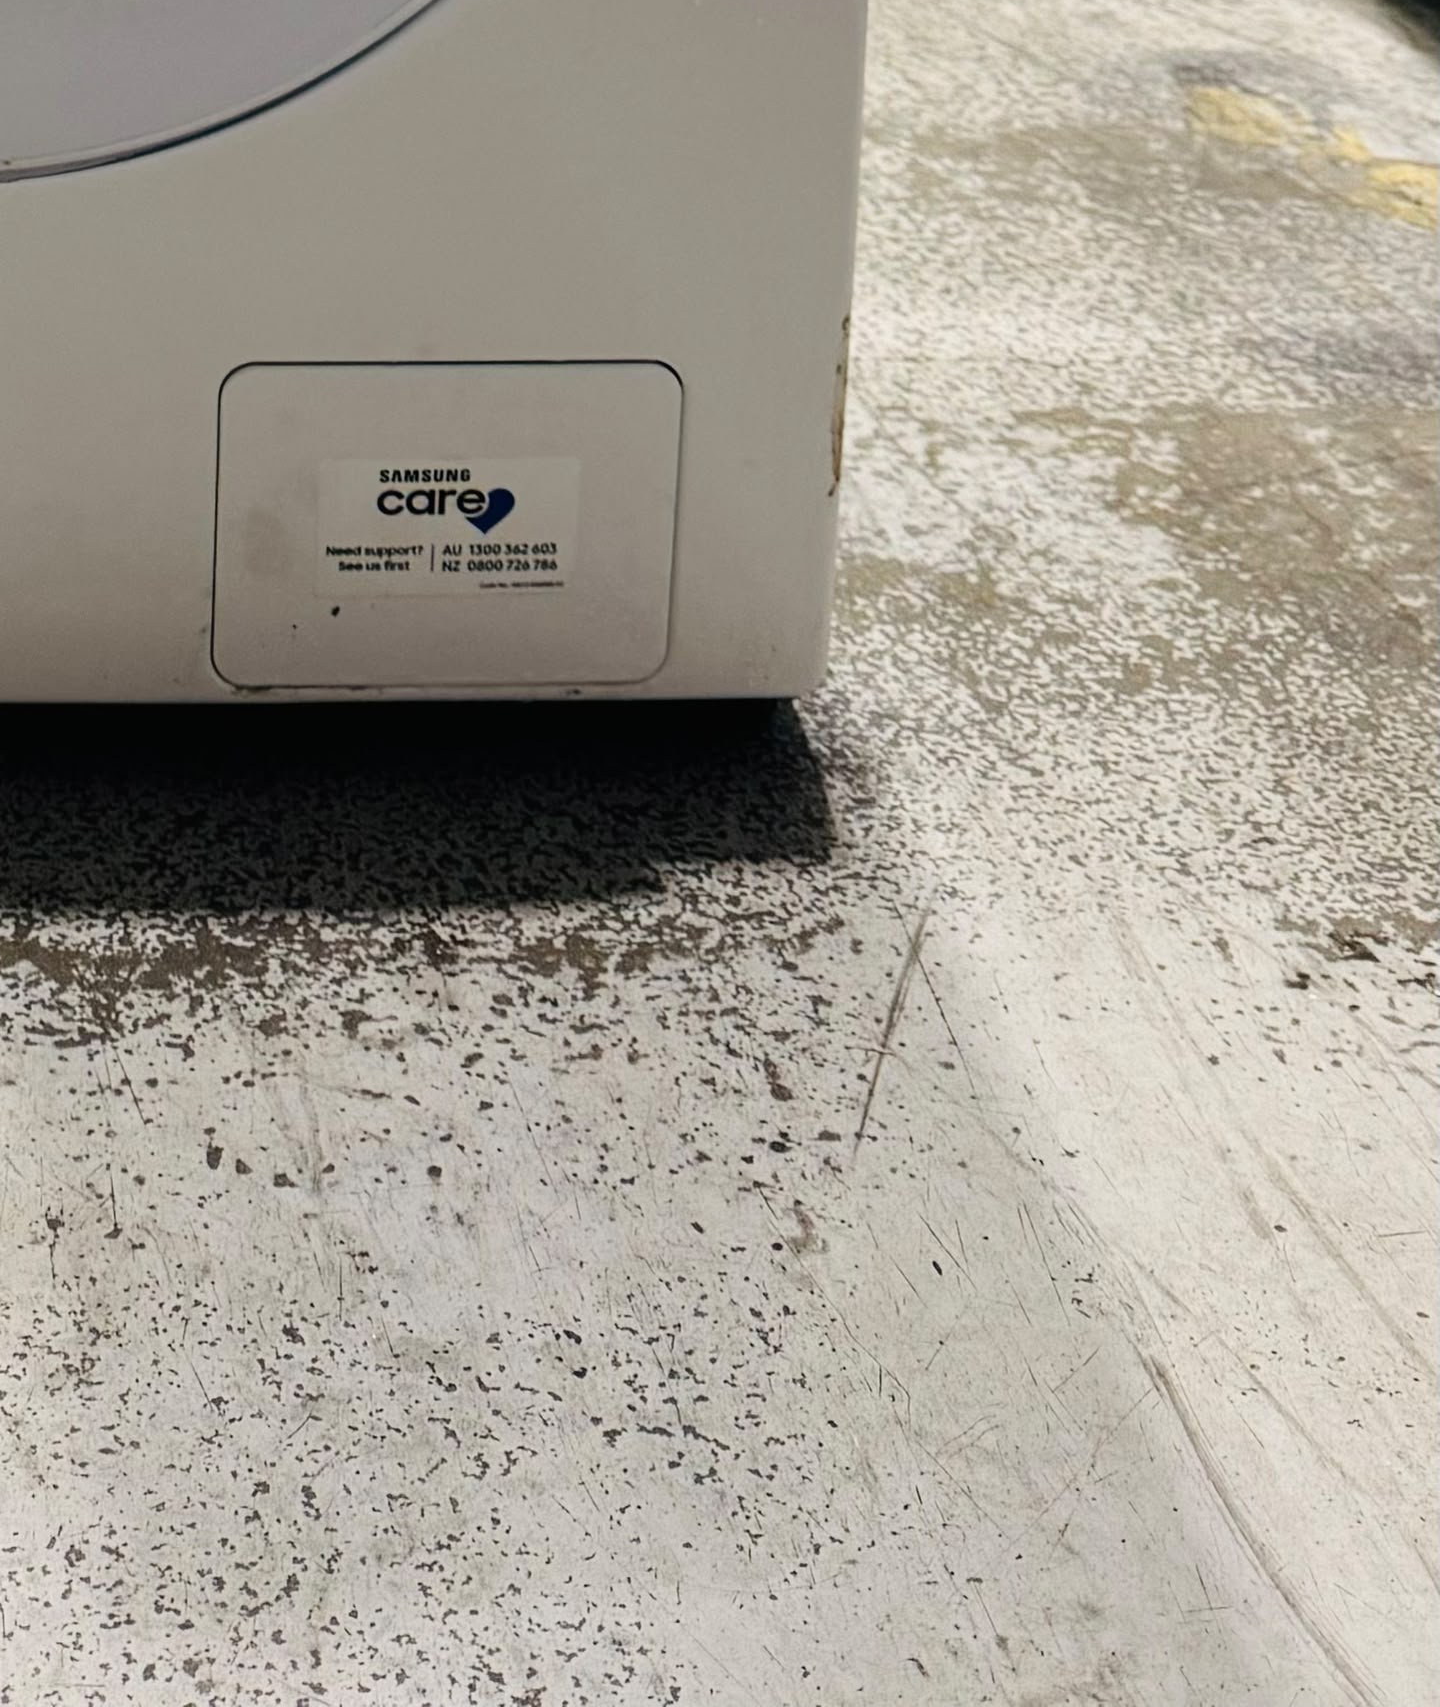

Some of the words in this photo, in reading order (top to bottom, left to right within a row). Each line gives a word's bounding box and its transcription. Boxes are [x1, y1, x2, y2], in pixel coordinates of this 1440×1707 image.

[379, 468, 472, 484] SAMSUNG
[376, 488, 487, 516] care
[326, 545, 362, 556] Need
[364, 545, 424, 560] support?
[442, 544, 462, 556] AU
[468, 543, 501, 556] 1300
[338, 561, 363, 572] See
[365, 562, 382, 572] us
[384, 560, 410, 572] first
[442, 560, 461, 573] NZ
[467, 560, 504, 573] 0800
